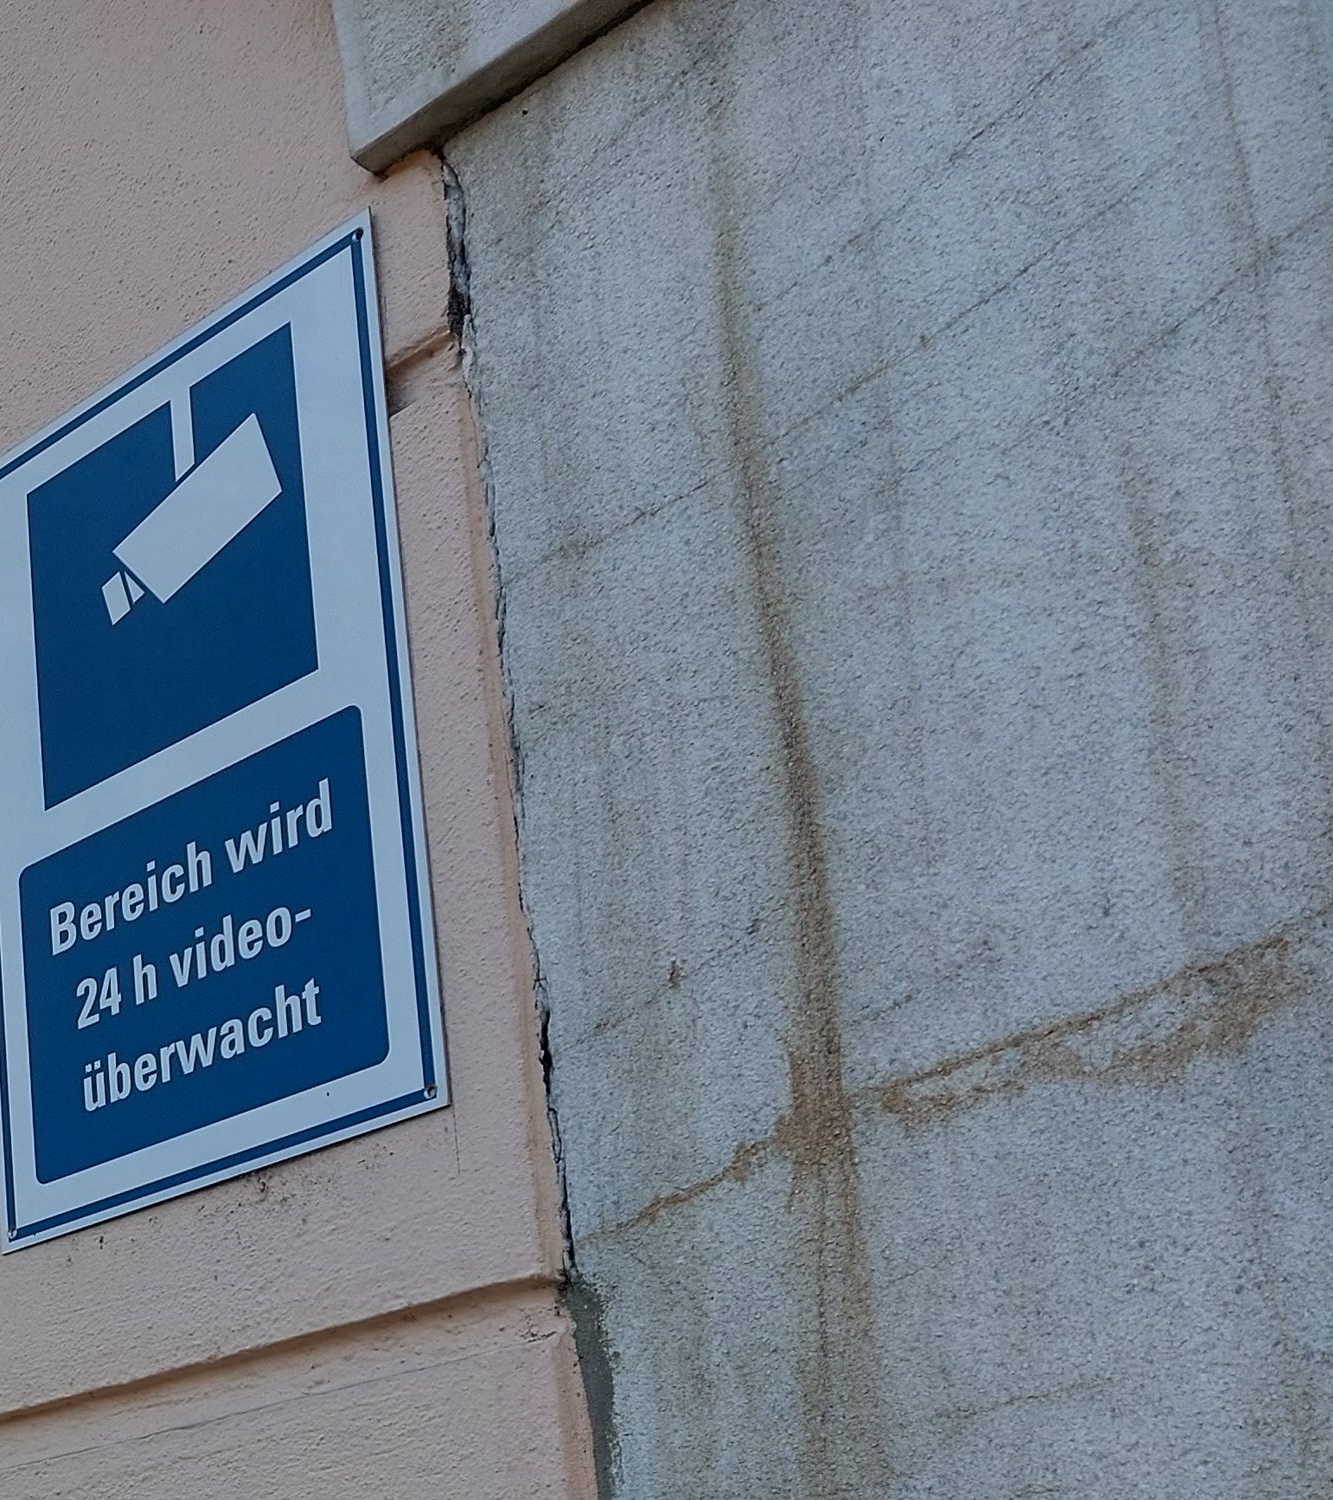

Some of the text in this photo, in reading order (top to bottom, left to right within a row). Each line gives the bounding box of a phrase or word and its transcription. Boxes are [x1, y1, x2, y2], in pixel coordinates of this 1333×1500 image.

[50, 778, 333, 956] Bereich wird
[76, 905, 312, 1030] 24 h video-
[82, 978, 322, 1112] überwacht
